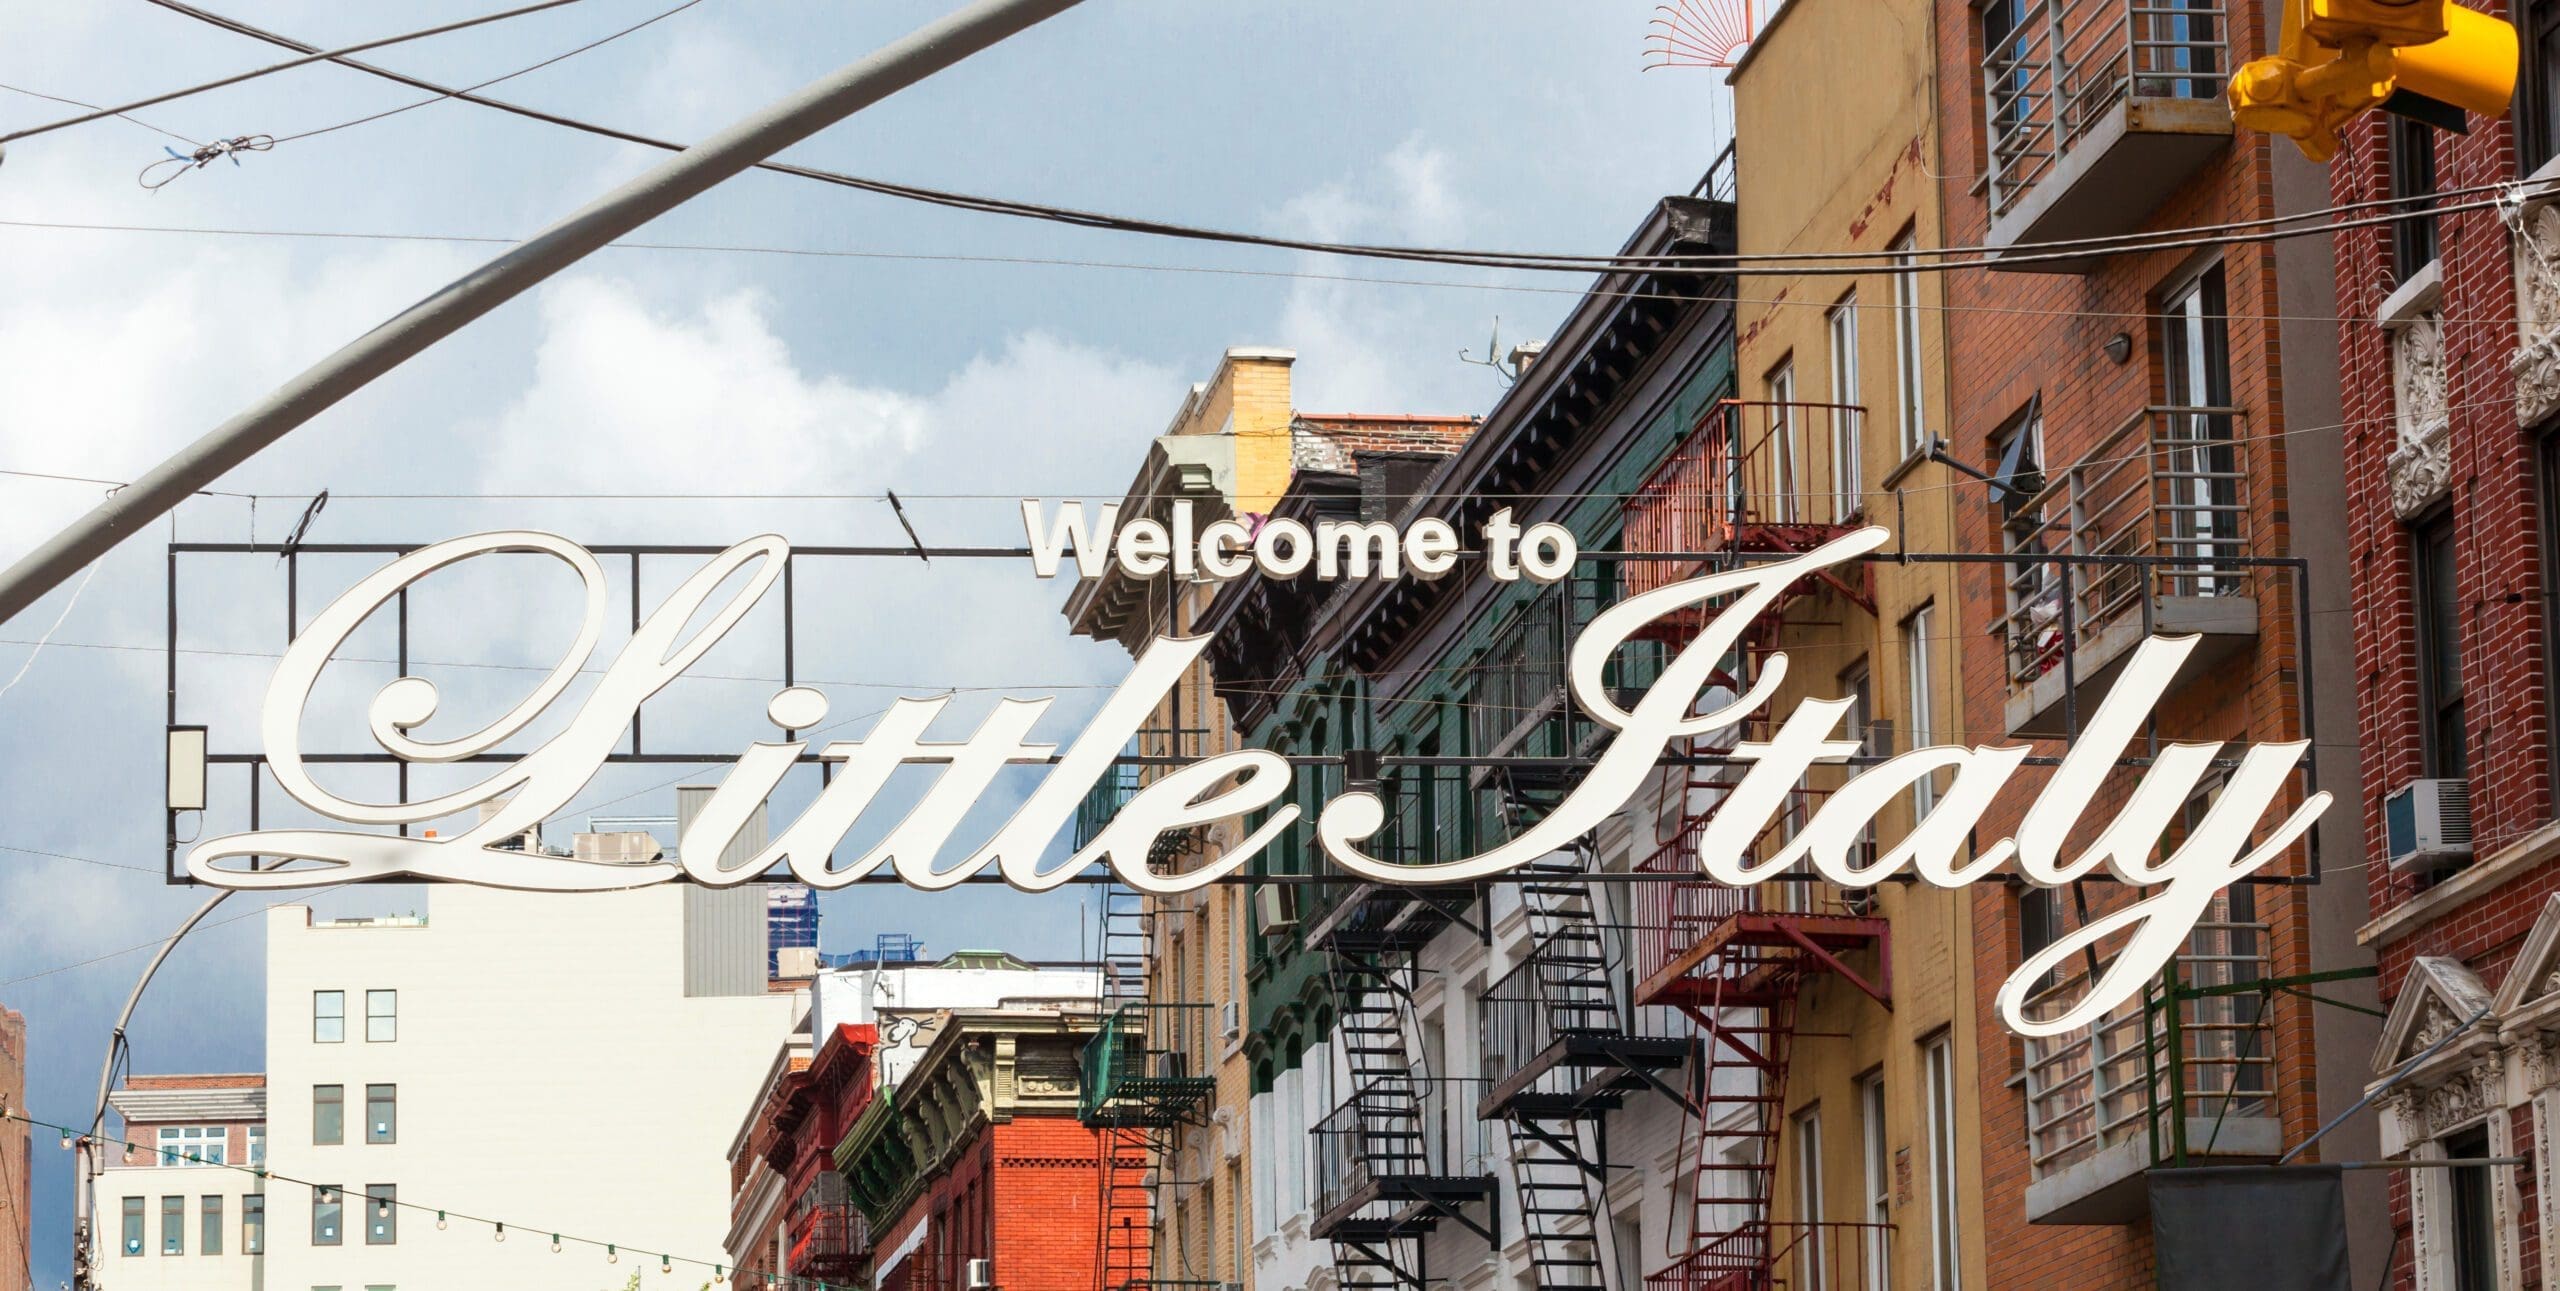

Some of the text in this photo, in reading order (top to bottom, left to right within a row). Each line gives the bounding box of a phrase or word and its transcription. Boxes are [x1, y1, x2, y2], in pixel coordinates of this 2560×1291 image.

[1021, 499, 1577, 583] Welcome to
[187, 527, 2332, 1037] Little Italy
